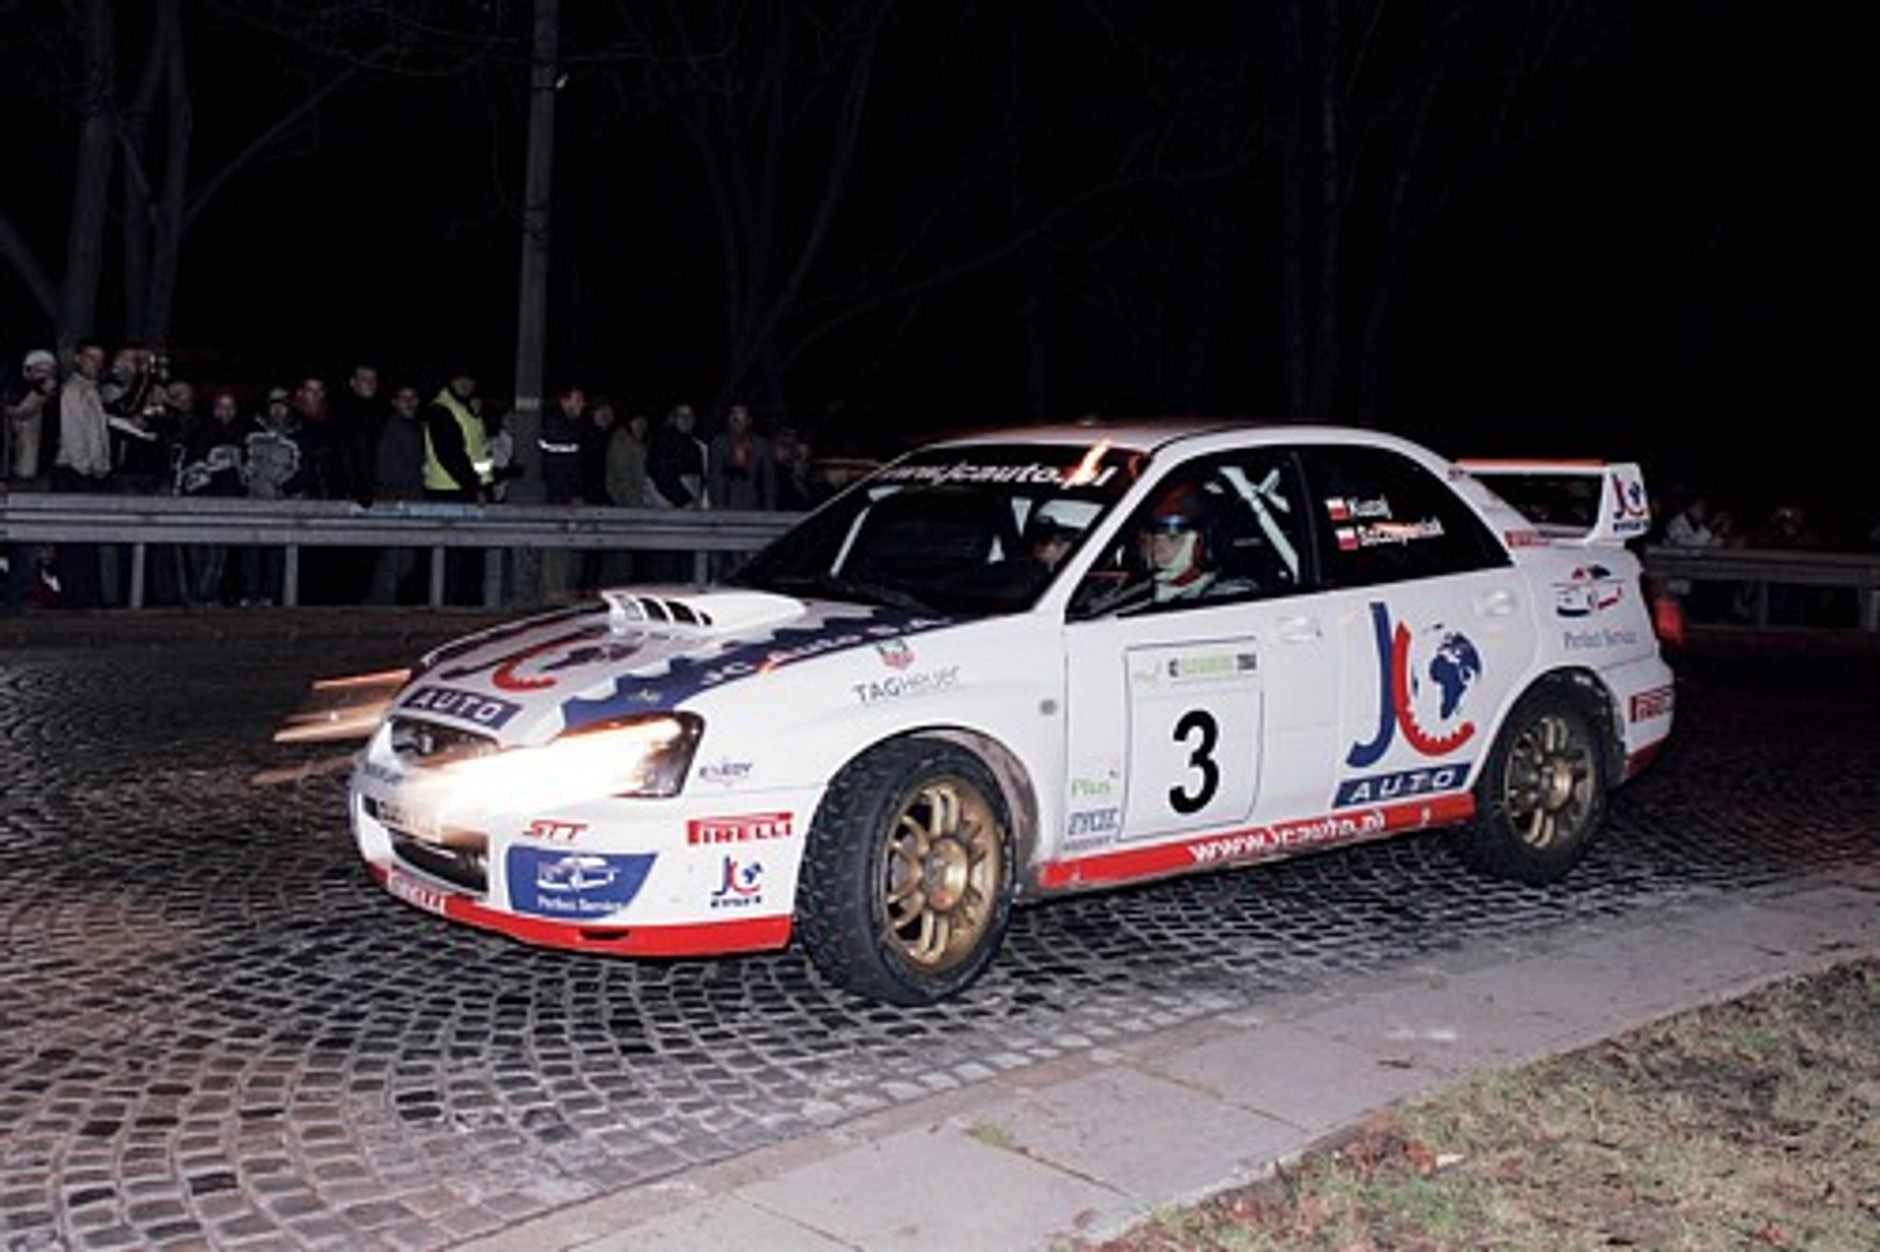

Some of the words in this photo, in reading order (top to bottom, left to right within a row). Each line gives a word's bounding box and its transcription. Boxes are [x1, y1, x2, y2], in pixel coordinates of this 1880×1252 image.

[413, 690, 503, 722] AUTO
[1168, 709, 1220, 814] 3
[1349, 768, 1456, 801] AUTO
[688, 812, 793, 845] PIRELLI
